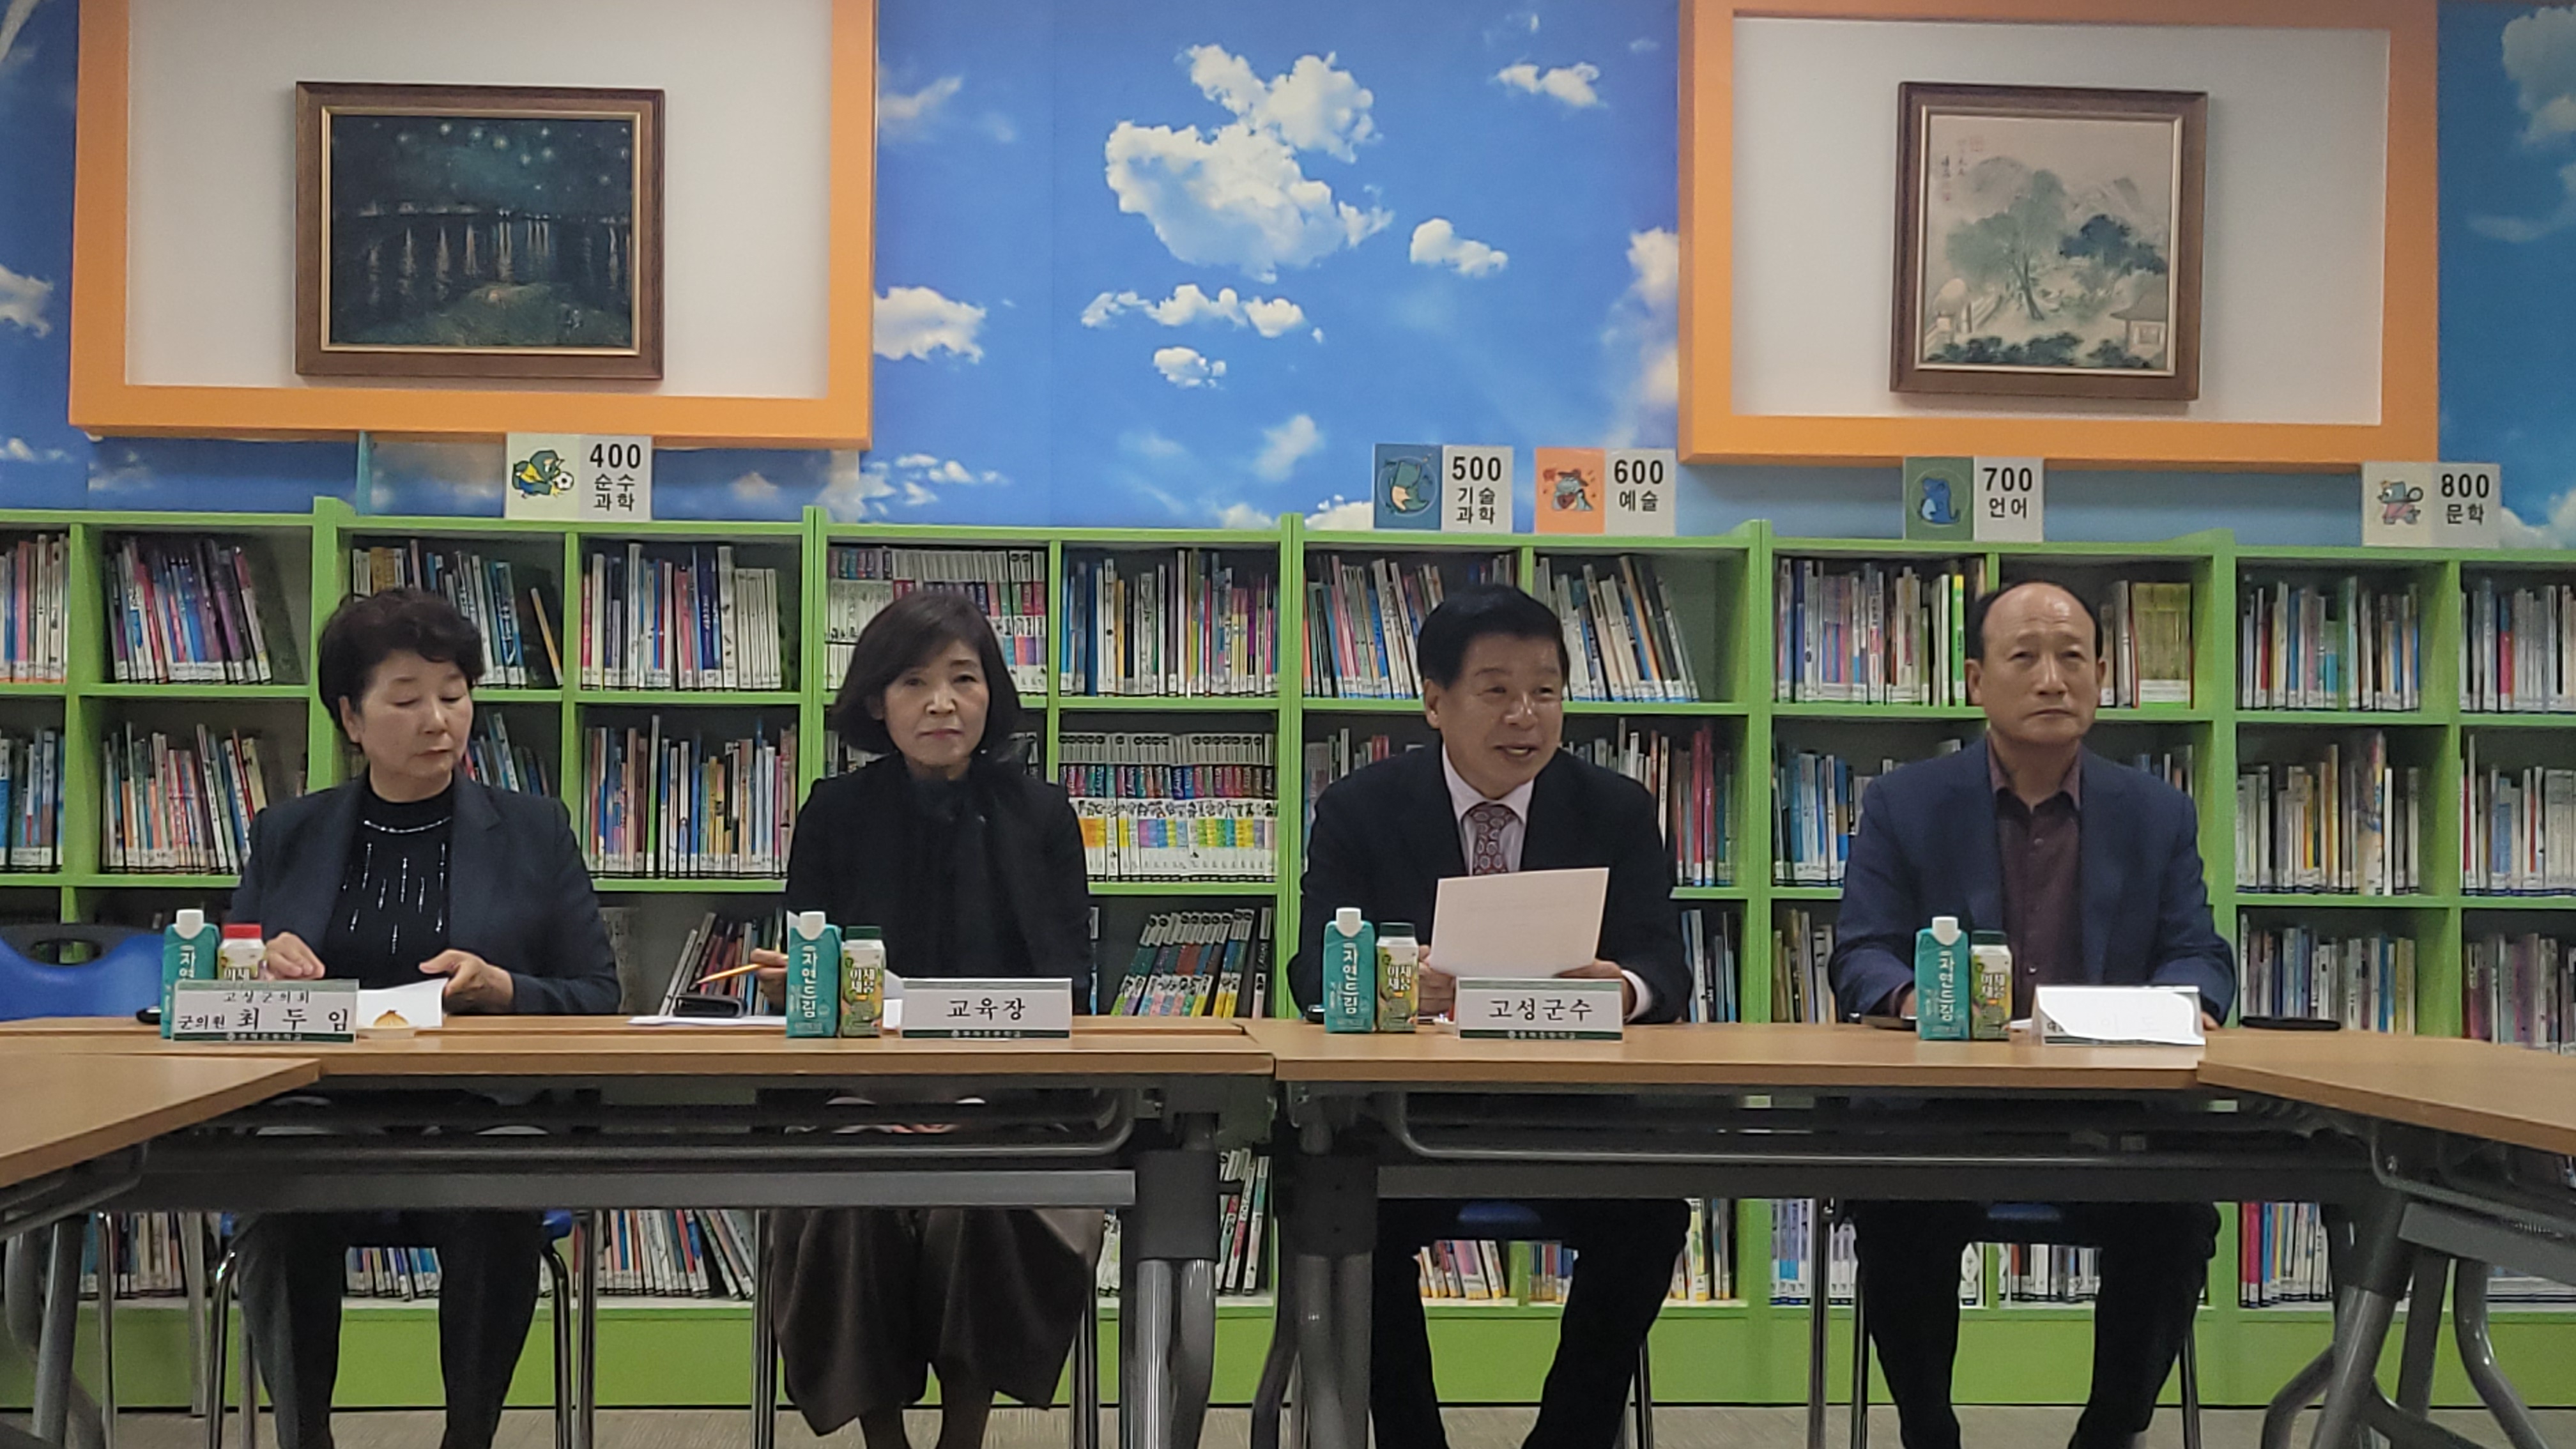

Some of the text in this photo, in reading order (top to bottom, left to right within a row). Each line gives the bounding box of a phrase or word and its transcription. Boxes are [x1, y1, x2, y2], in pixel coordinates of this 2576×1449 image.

[590, 443, 641, 468] 400
[1452, 456, 1502, 481] 500
[1614, 459, 1664, 485] 600
[1982, 467, 2032, 491] 700
[594, 473, 635, 492] 순수
[2441, 473, 2489, 498] 800
[594, 493, 635, 512] 과학
[1457, 487, 1496, 505] 기술
[1618, 490, 1659, 512] 예술
[1989, 496, 2028, 519] 언어
[1455, 505, 1496, 524] 과학
[2446, 503, 2485, 525] 문학
[802, 949, 818, 1018] 자연드림
[1343, 947, 1359, 1015] 자연드림
[1939, 954, 1956, 1022] 자연드림
[947, 997, 1026, 1021] 교육장
[1489, 997, 1593, 1022] 고성군수
[178, 1015, 226, 1030] 군의원
